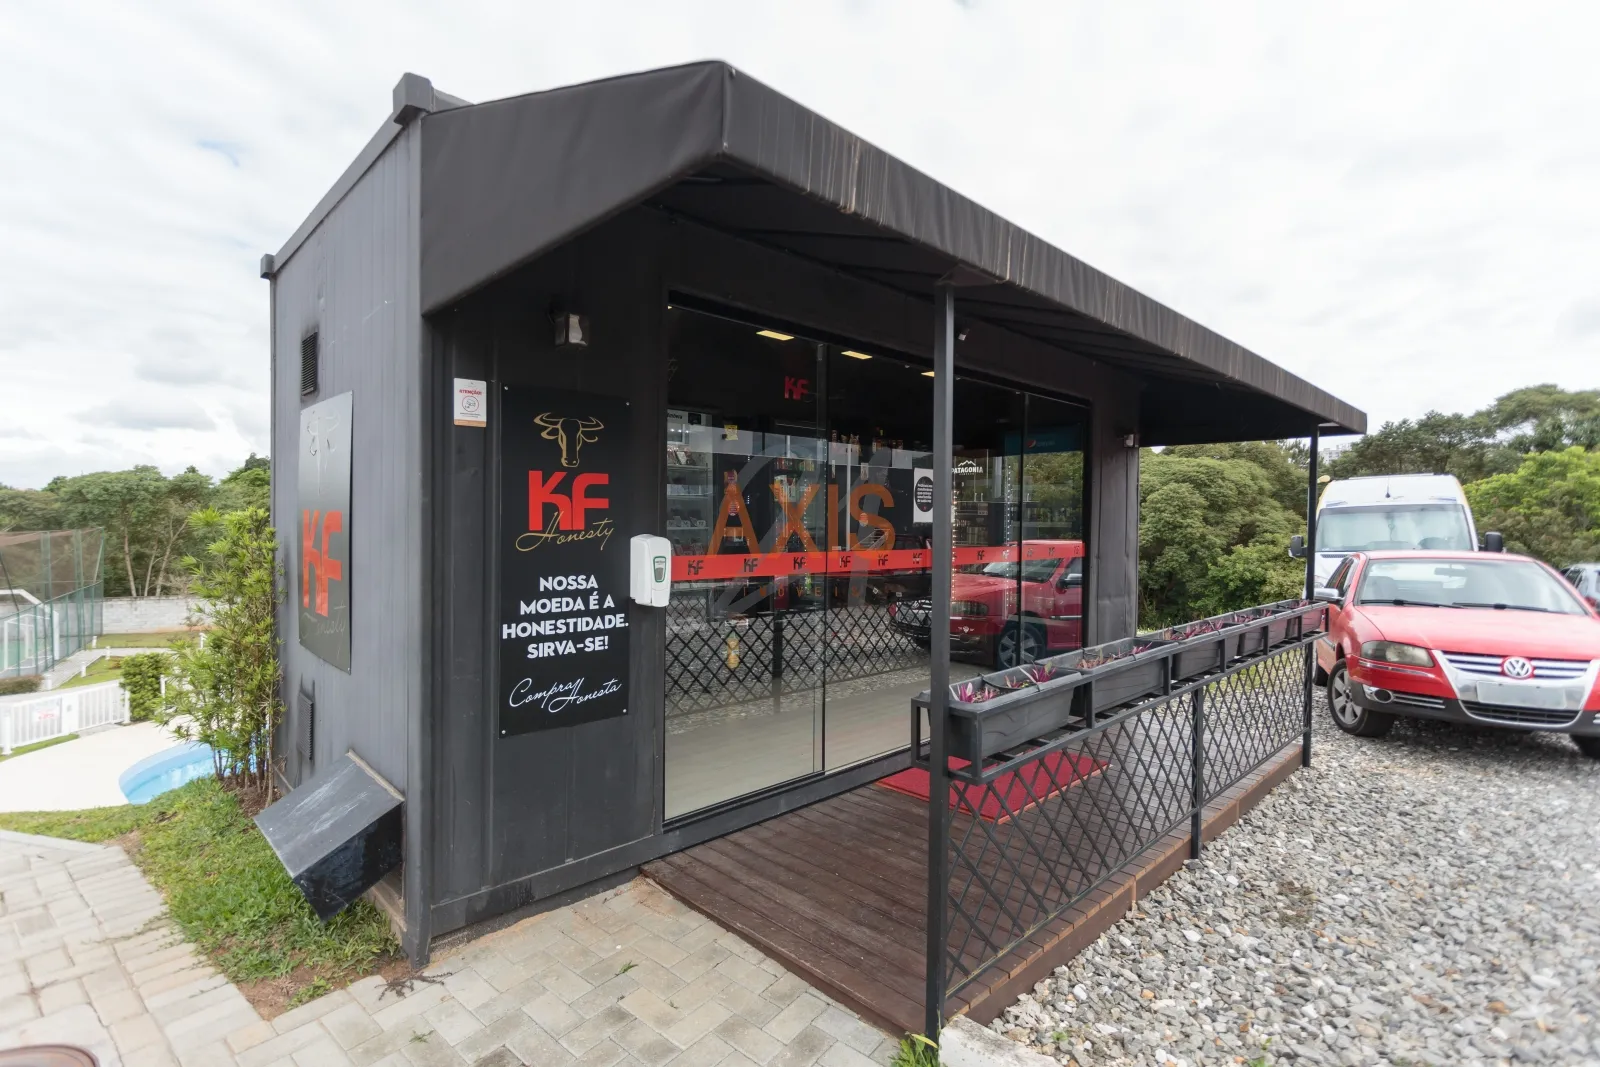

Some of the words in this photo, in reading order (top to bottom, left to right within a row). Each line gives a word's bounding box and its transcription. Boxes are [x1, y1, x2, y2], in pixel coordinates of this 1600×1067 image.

[951, 466, 984, 474] PATAGONIA
[528, 470, 609, 531] KF
[515, 510, 615, 552] Honesty
[302, 509, 343, 617] KF
[539, 574, 599, 592] NOSSA
[520, 596, 586, 616] MOEDA
[589, 591, 600, 610] É
[602, 594, 616, 609] A
[502, 613, 630, 640] HONESTIDADE.
[526, 635, 609, 659] SIRVA-SE!
[508, 677, 577, 709] Compra
[547, 677, 623, 713] Honesta
